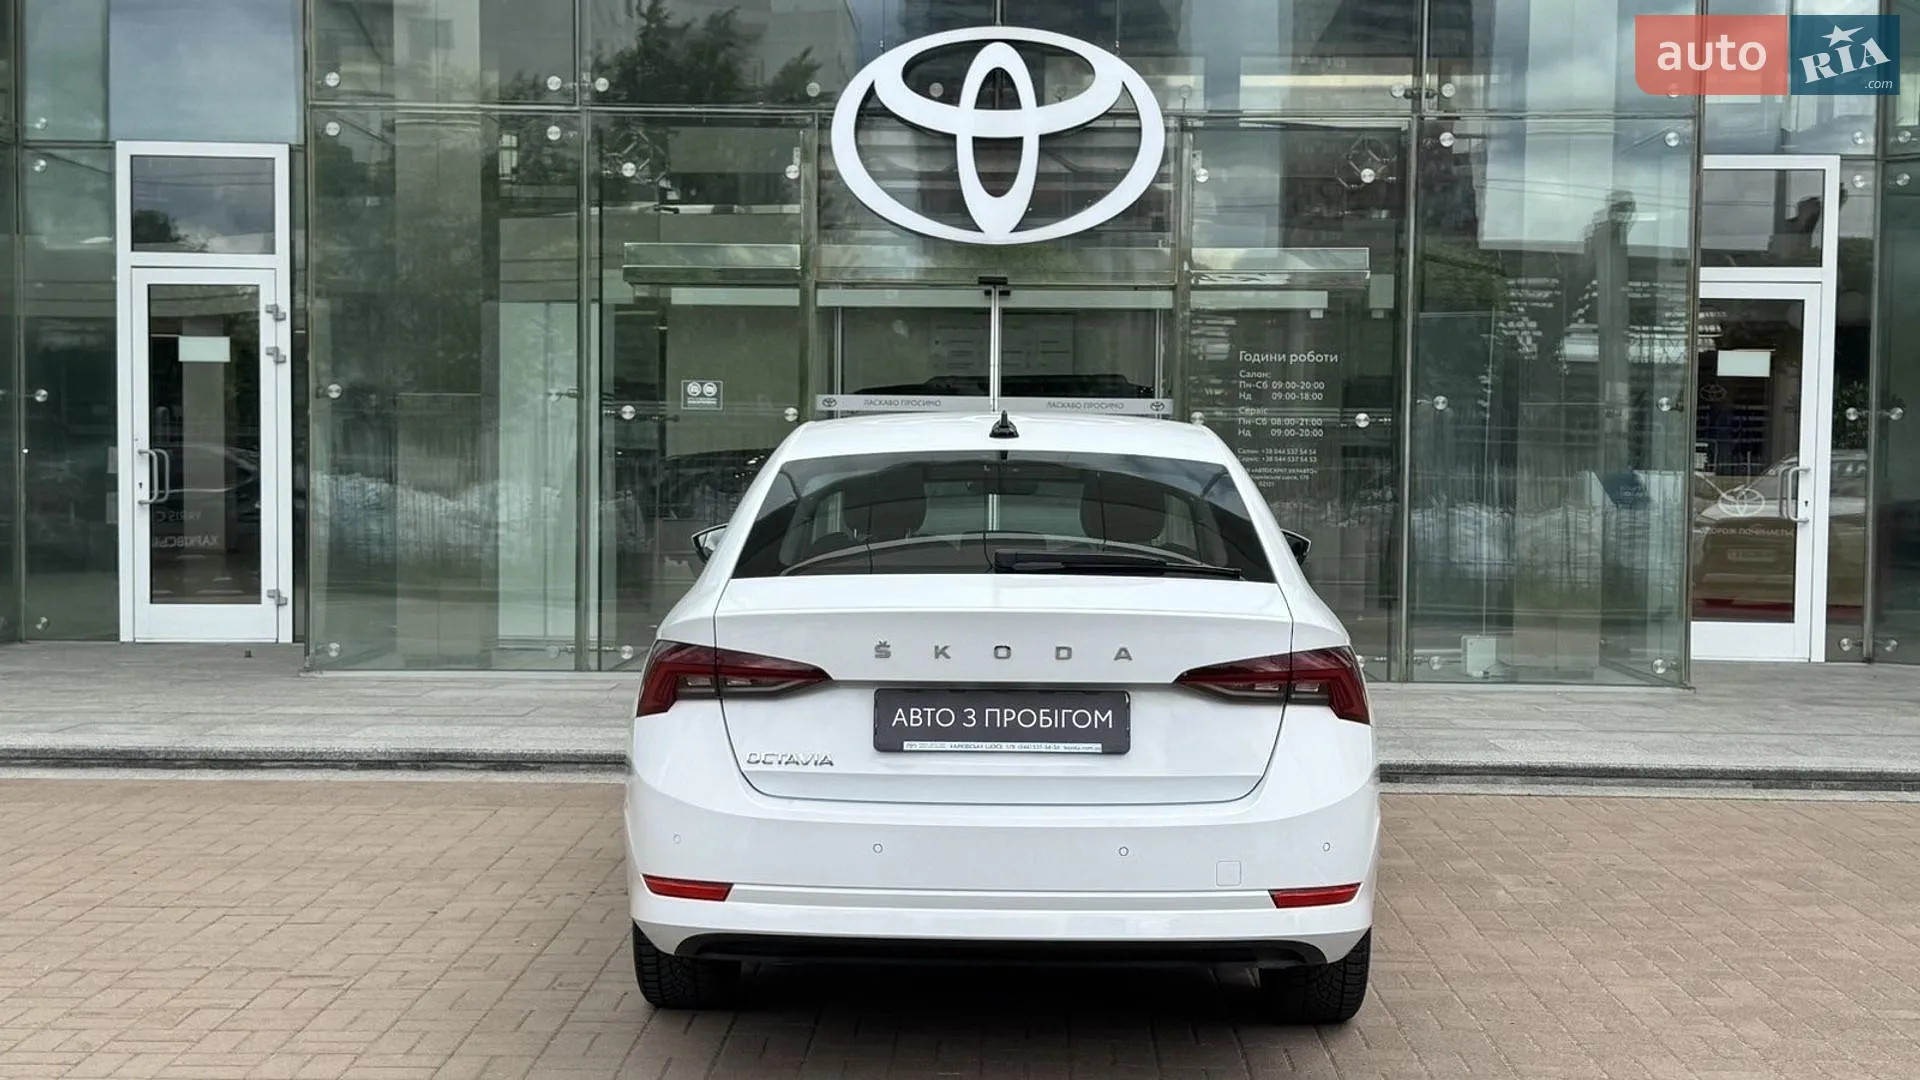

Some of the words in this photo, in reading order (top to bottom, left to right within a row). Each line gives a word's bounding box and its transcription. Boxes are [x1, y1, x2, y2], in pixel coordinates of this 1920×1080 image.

[1239, 351, 1286, 364] Години
[1289, 350, 1339, 365] роботи
[1239, 381, 1269, 389] Пн-Сб
[1239, 392, 1252, 401] Нд
[1238, 417, 1268, 426] Пн-Сб
[1238, 428, 1252, 437] Нд
[874, 640, 1133, 661] ŠKODA
[891, 707, 956, 728] АВТО
[962, 708, 977, 728] З
[984, 708, 1113, 729] ПРОБІГОМ
[746, 752, 834, 766] OCTAVIA
